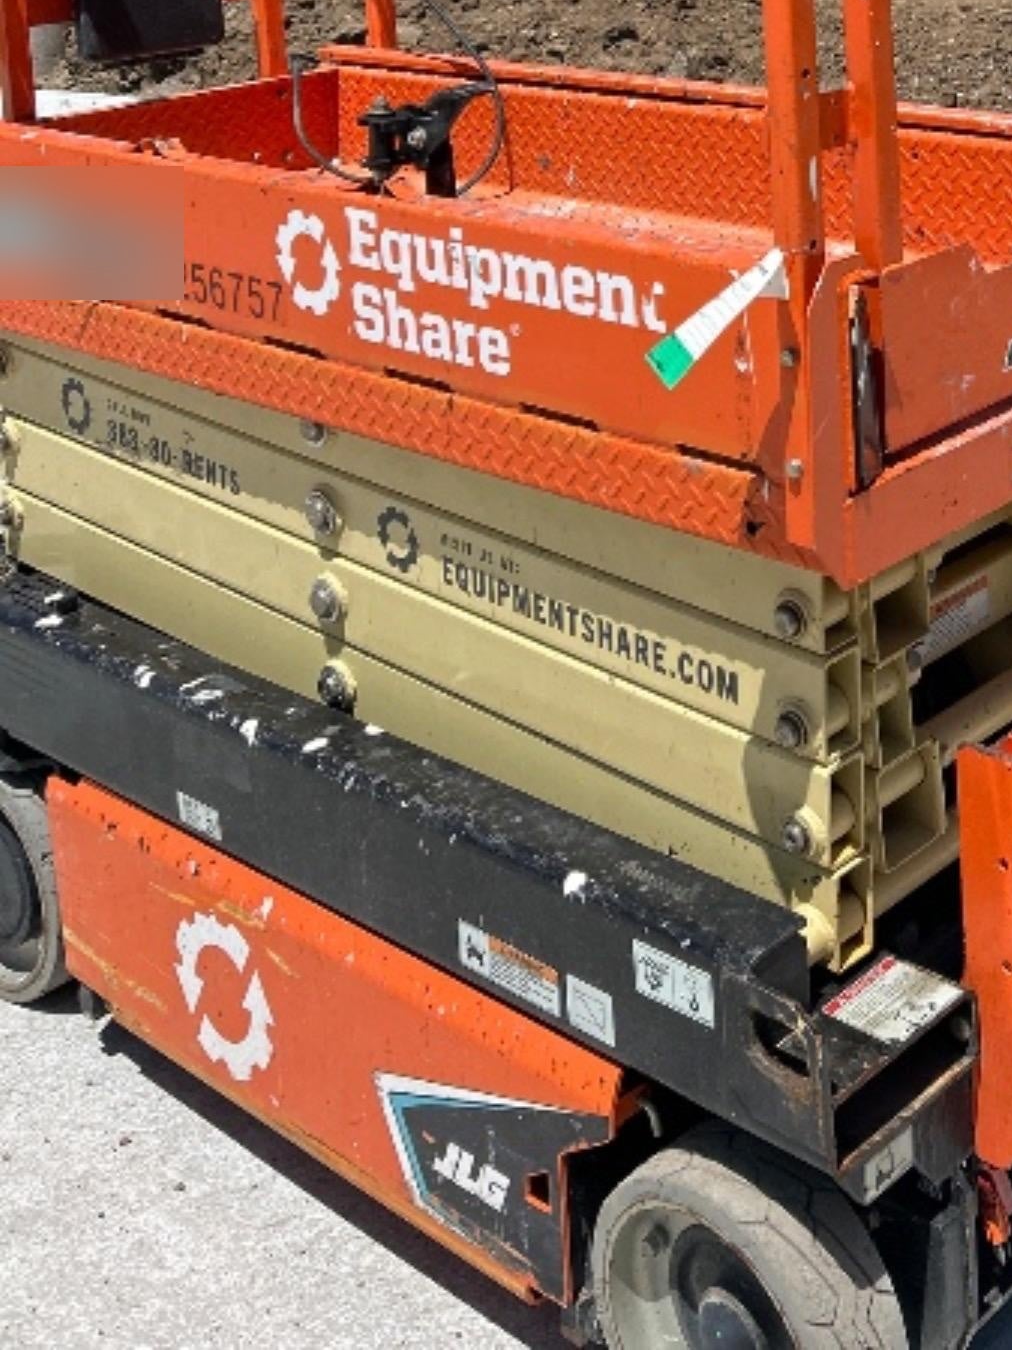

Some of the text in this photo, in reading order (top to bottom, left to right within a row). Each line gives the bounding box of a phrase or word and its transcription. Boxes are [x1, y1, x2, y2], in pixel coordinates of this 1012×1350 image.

[184, 262, 283, 322] 56757
[344, 206, 667, 334] Equipment
[352, 281, 512, 377] Share
[441, 555, 740, 706] EQUIPMENTSHARE.COM
[431, 1141, 512, 1213] JLG
